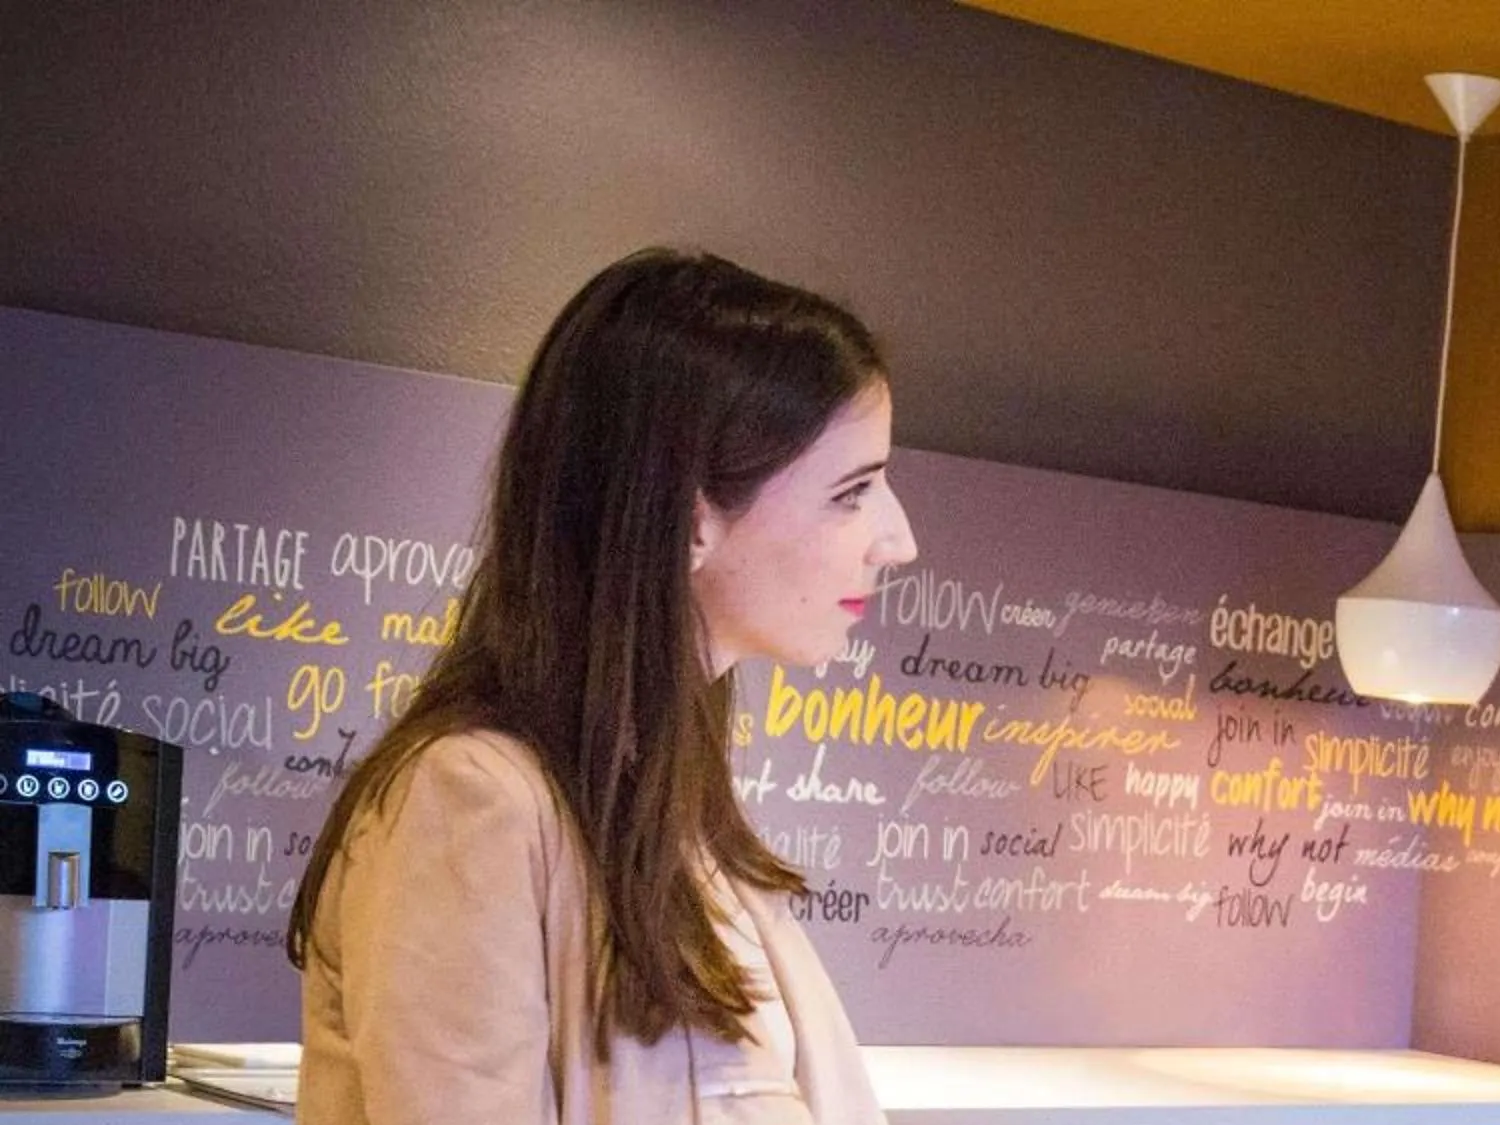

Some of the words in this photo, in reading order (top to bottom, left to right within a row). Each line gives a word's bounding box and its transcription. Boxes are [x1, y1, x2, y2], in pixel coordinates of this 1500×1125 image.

[171, 517, 309, 590] PARTAGE
[55, 568, 163, 619] follow
[214, 591, 349, 646] like
[877, 565, 1004, 634] follow
[10, 604, 156, 670] dream
[170, 619, 231, 692] big
[1100, 629, 1197, 686] partage
[1210, 594, 1334, 670] échange
[287, 664, 345, 739] go
[901, 634, 1026, 688] dream
[1039, 648, 1090, 714] big
[1124, 674, 1198, 721] social
[142, 694, 272, 752] social
[765, 665, 985, 753] bonheur
[1207, 703, 1260, 768] join
[1274, 707, 1297, 747] in
[786, 742, 887, 806] share
[983, 703, 1181, 788] inspirer
[1303, 730, 1431, 795] simplicité
[899, 756, 1022, 813] follow
[1125, 761, 1200, 809] happy
[1313, 793, 1373, 832] join
[1376, 798, 1405, 823] in
[1408, 780, 1476, 847] why
[247, 817, 272, 862] in
[867, 810, 929, 867] join
[942, 814, 969, 861] in
[981, 823, 1063, 858] social
[1070, 809, 1211, 875] simplicité
[1228, 818, 1291, 887] why
[1302, 824, 1352, 863] not
[178, 860, 272, 914] trust
[875, 864, 968, 912] trust
[1215, 885, 1296, 928] follow
[1301, 866, 1368, 922] begin
